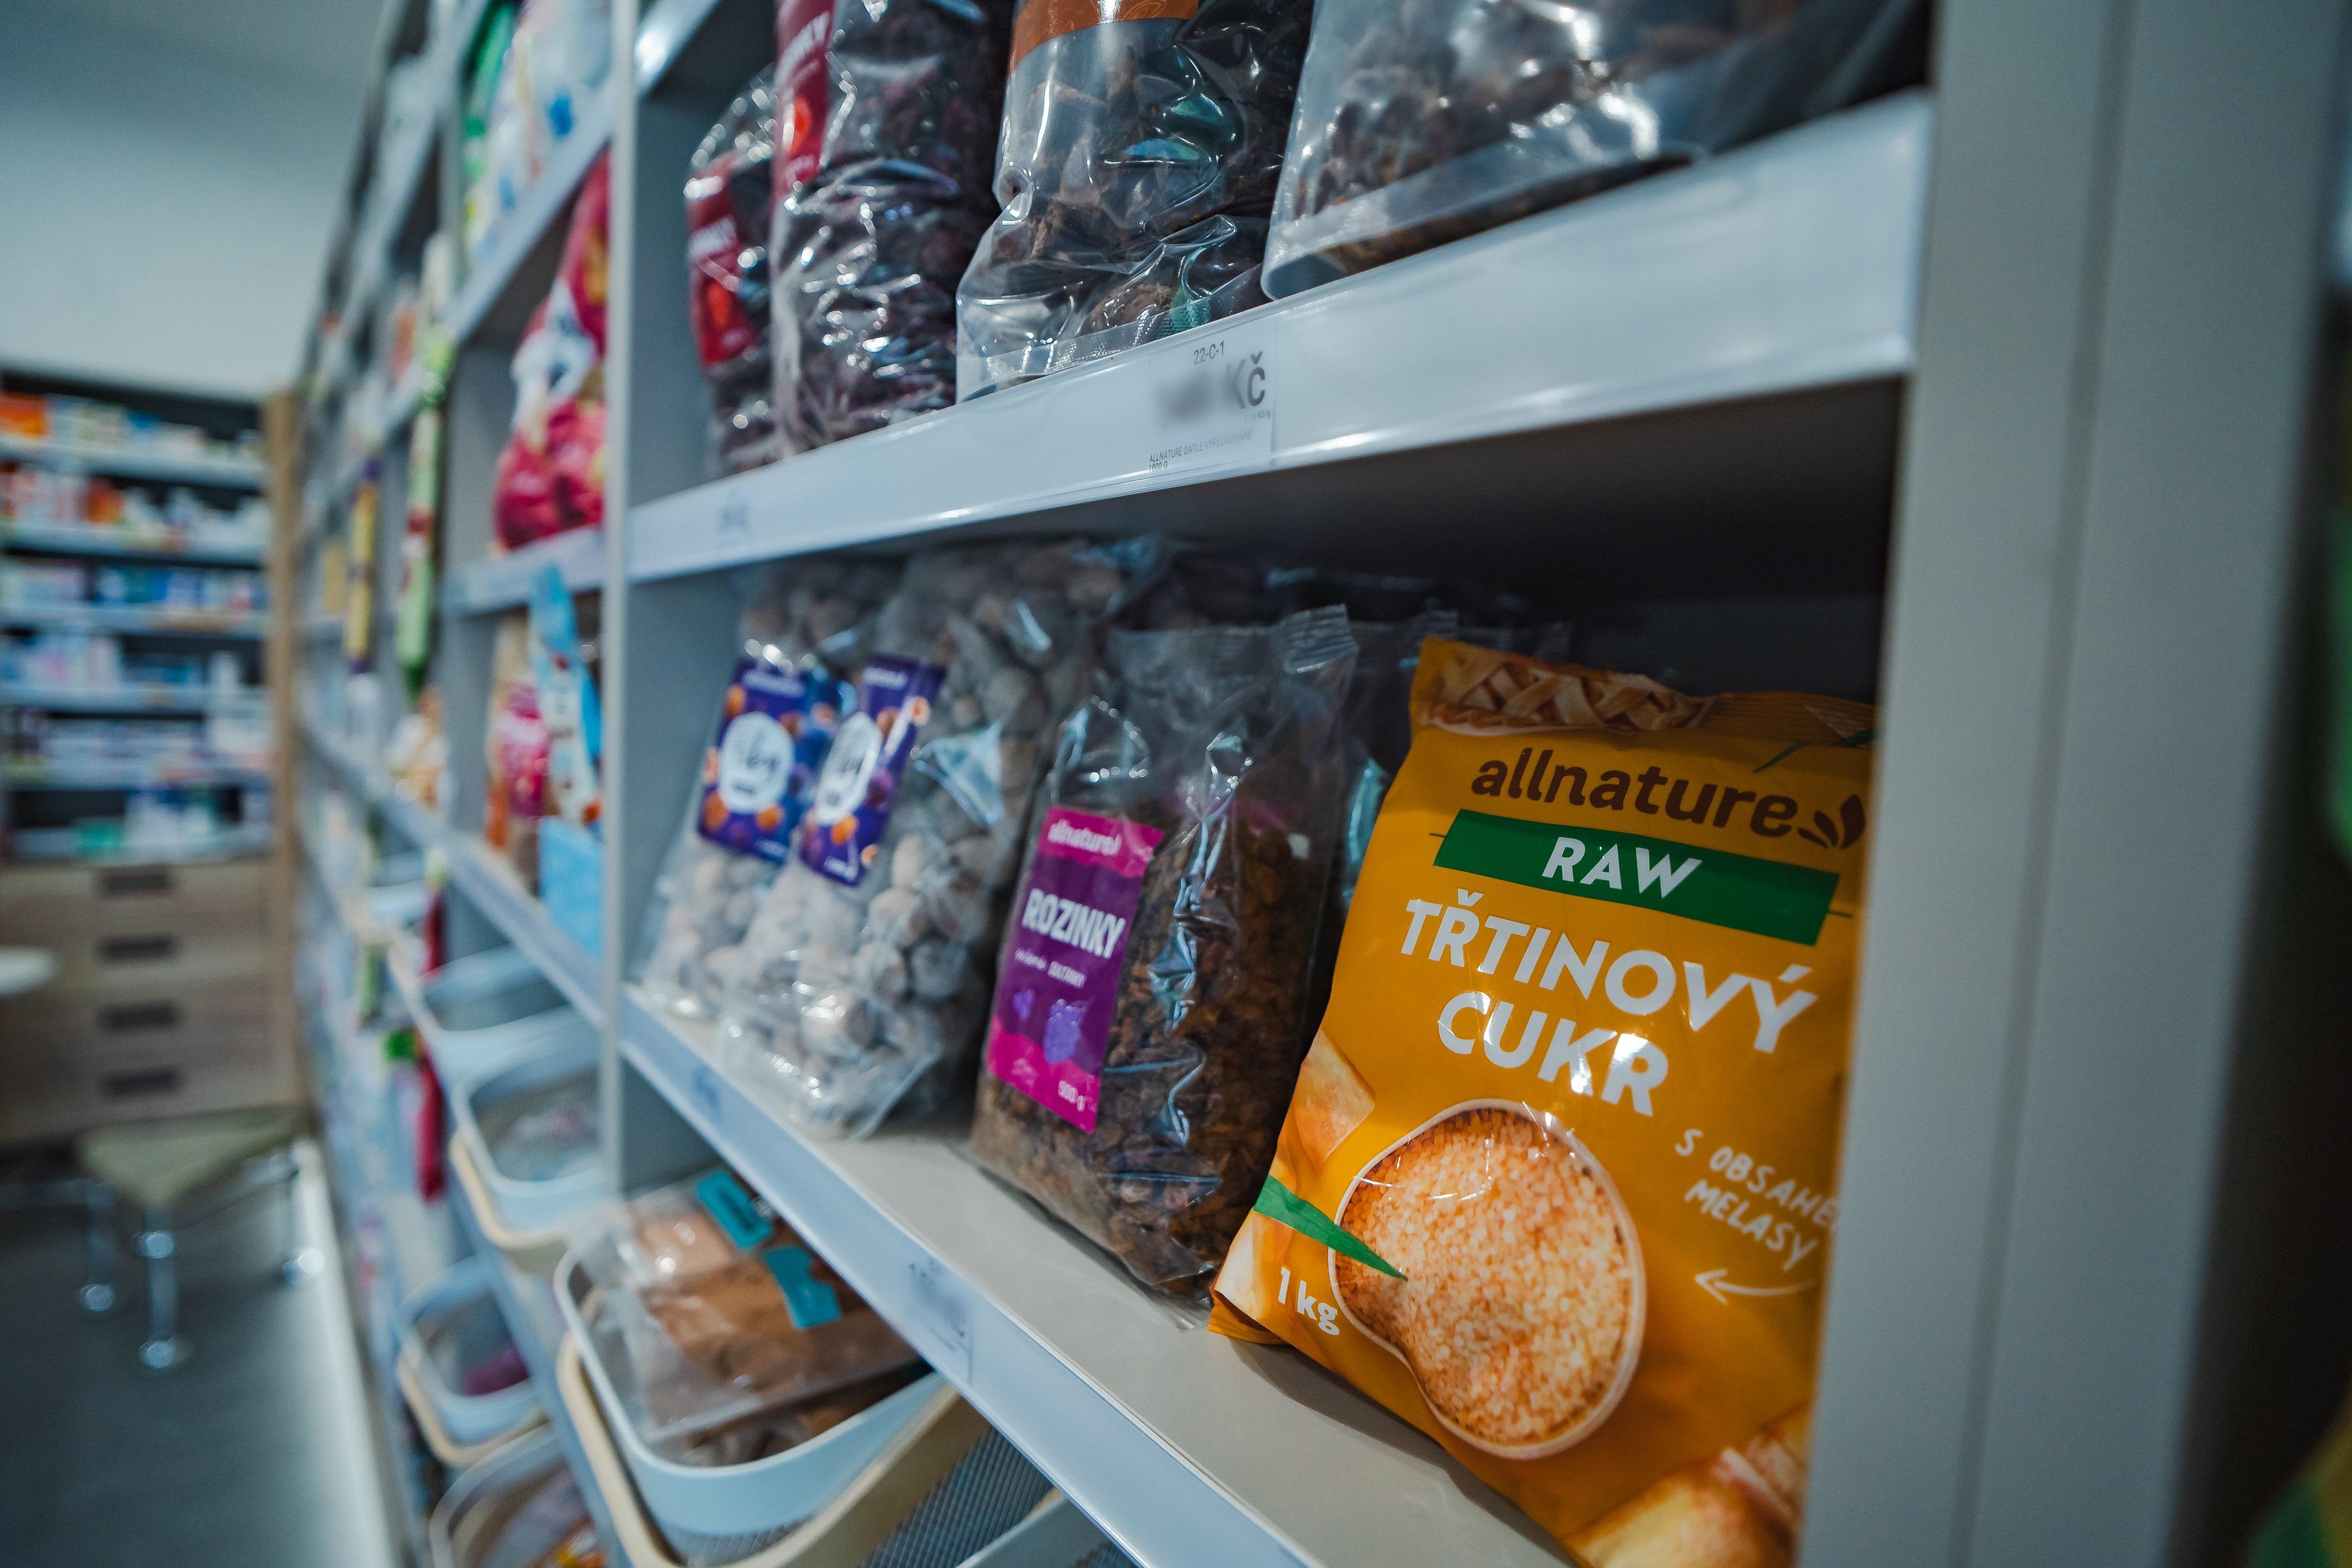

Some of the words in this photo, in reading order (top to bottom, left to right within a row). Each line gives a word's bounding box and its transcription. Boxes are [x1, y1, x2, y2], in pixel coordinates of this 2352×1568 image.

[1194, 340, 1224, 365] 22-C-1
[1149, 446, 1182, 463] ALLNATURE
[1184, 441, 1203, 455] DATLE
[1204, 428, 1252, 449] VYPECKOVANÉ
[1149, 462, 1162, 472] 1000
[1162, 460, 1168, 469] G
[1471, 747, 1797, 838] allnature
[1542, 837, 1702, 898] RAW
[1021, 888, 1126, 959] ROZINKY
[1400, 887, 1818, 1054] TŘTINOVÝ
[1438, 990, 1669, 1117] CUKR
[1674, 1128, 1696, 1158] S
[1684, 1178, 1819, 1271] MELASY
